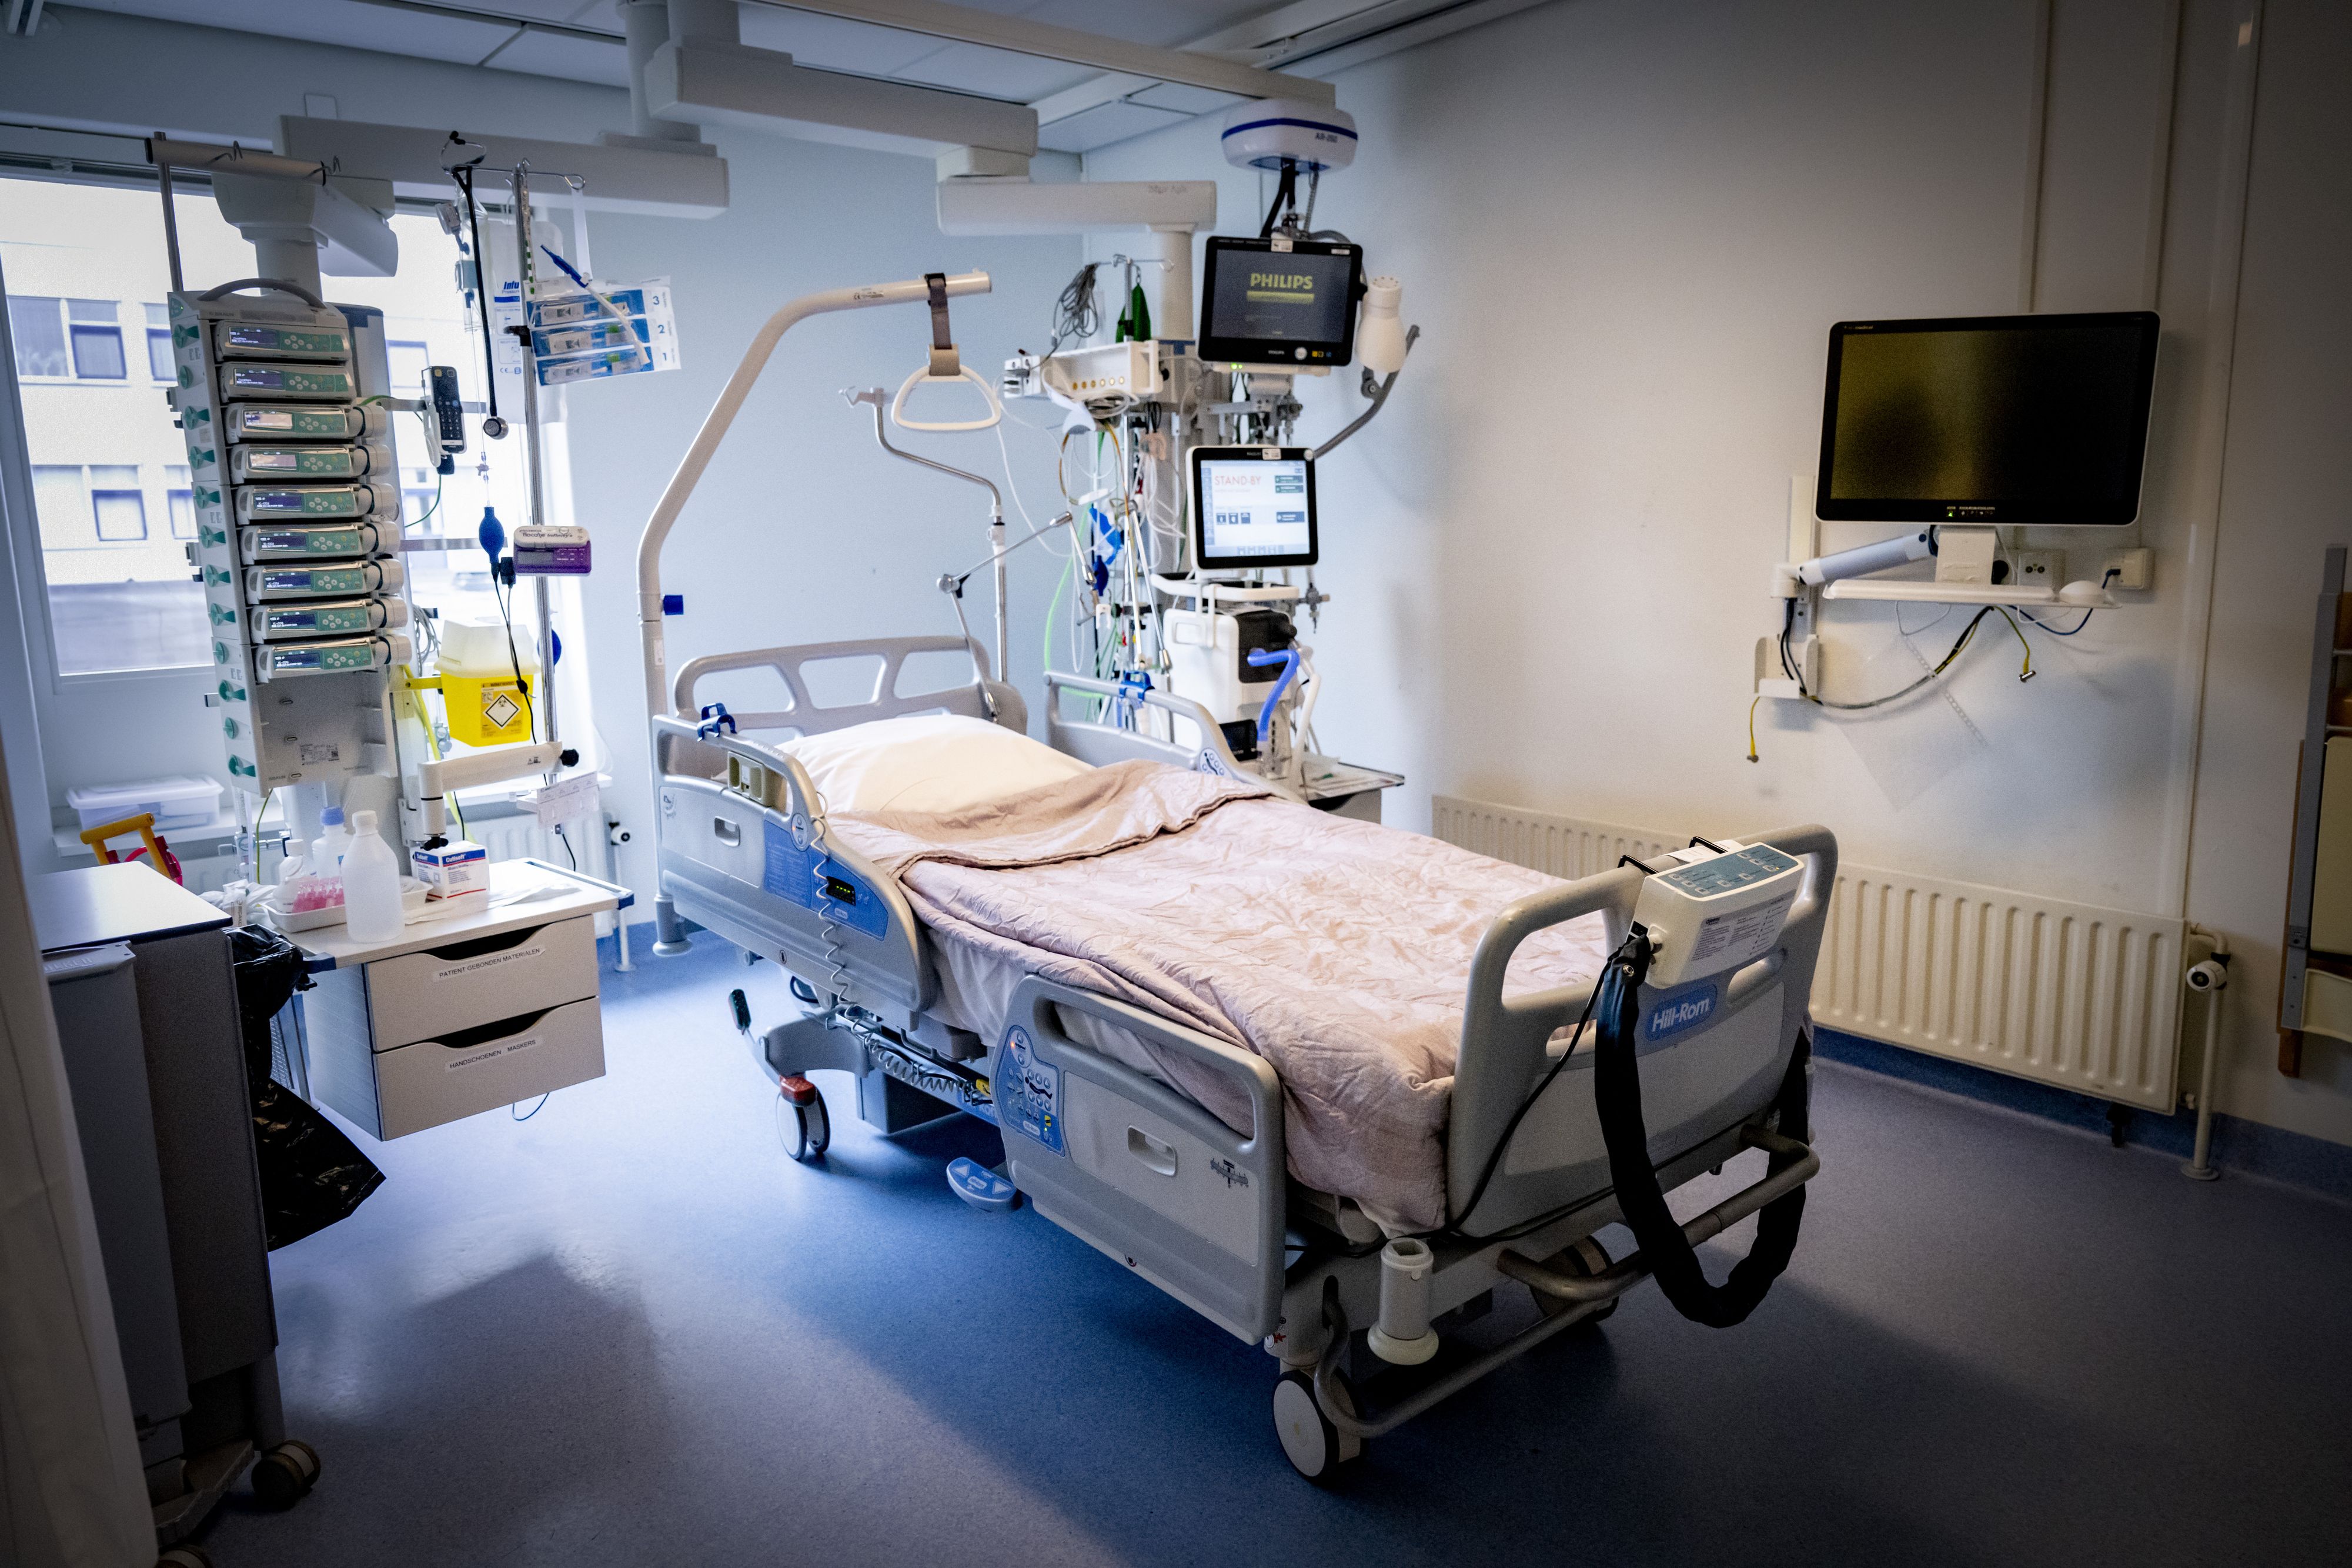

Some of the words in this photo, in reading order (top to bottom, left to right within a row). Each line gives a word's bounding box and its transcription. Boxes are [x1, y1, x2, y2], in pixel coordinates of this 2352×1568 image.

[503, 280, 520, 290] Infu
[1251, 273, 1312, 290] PHILIPS
[652, 296, 660, 305] 3
[657, 325, 665, 334] 2
[662, 352, 667, 362] 1
[1214, 475, 1262, 486] STAND-BY
[446, 854, 465, 862] Cutisoft
[439, 967, 466, 978] PATIENT
[467, 958, 502, 971] GEBONDEN
[502, 948, 540, 962] MATERIALEN
[1652, 998, 1710, 1032] Hill-Rom
[449, 1049, 502, 1069] HANDSCHOENEN
[507, 1039, 536, 1052] MASKERS
